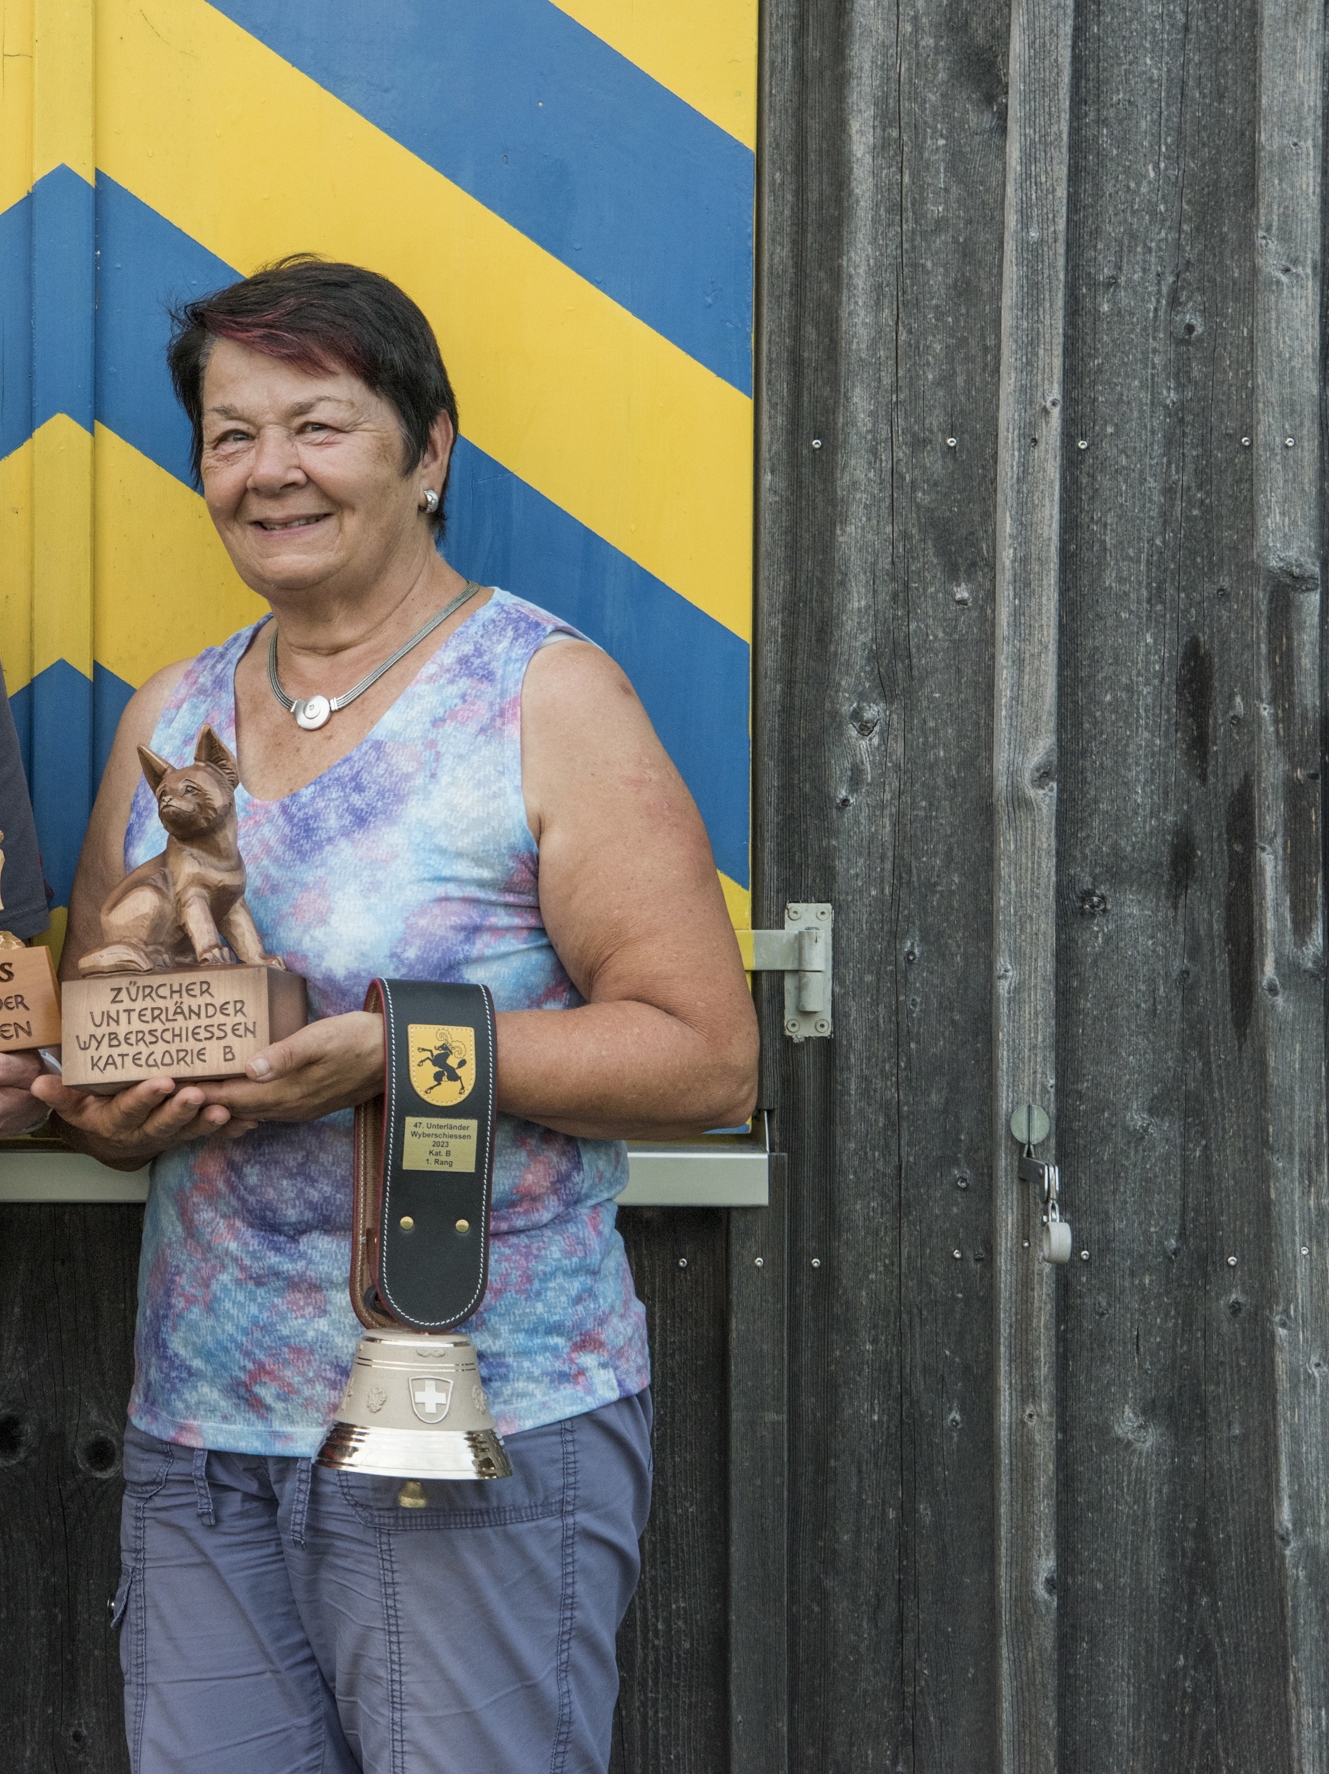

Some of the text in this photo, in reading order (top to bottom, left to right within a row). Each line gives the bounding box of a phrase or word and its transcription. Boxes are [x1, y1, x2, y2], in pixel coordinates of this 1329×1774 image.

[105, 981, 214, 1004] ZÜRCHER
[89, 1000, 248, 1028] UNTERLÄNDER
[75, 1021, 257, 1051] WYBERSCHIESSEN
[90, 1045, 236, 1074] KATEGORIE B
[426, 1122, 470, 1131] Unterländer
[411, 1130, 472, 1140] Wyberschiessen
[432, 1140, 450, 1148] 2023
[428, 1149, 444, 1157] Kat.
[425, 1158, 454, 1168] 1. Rang
